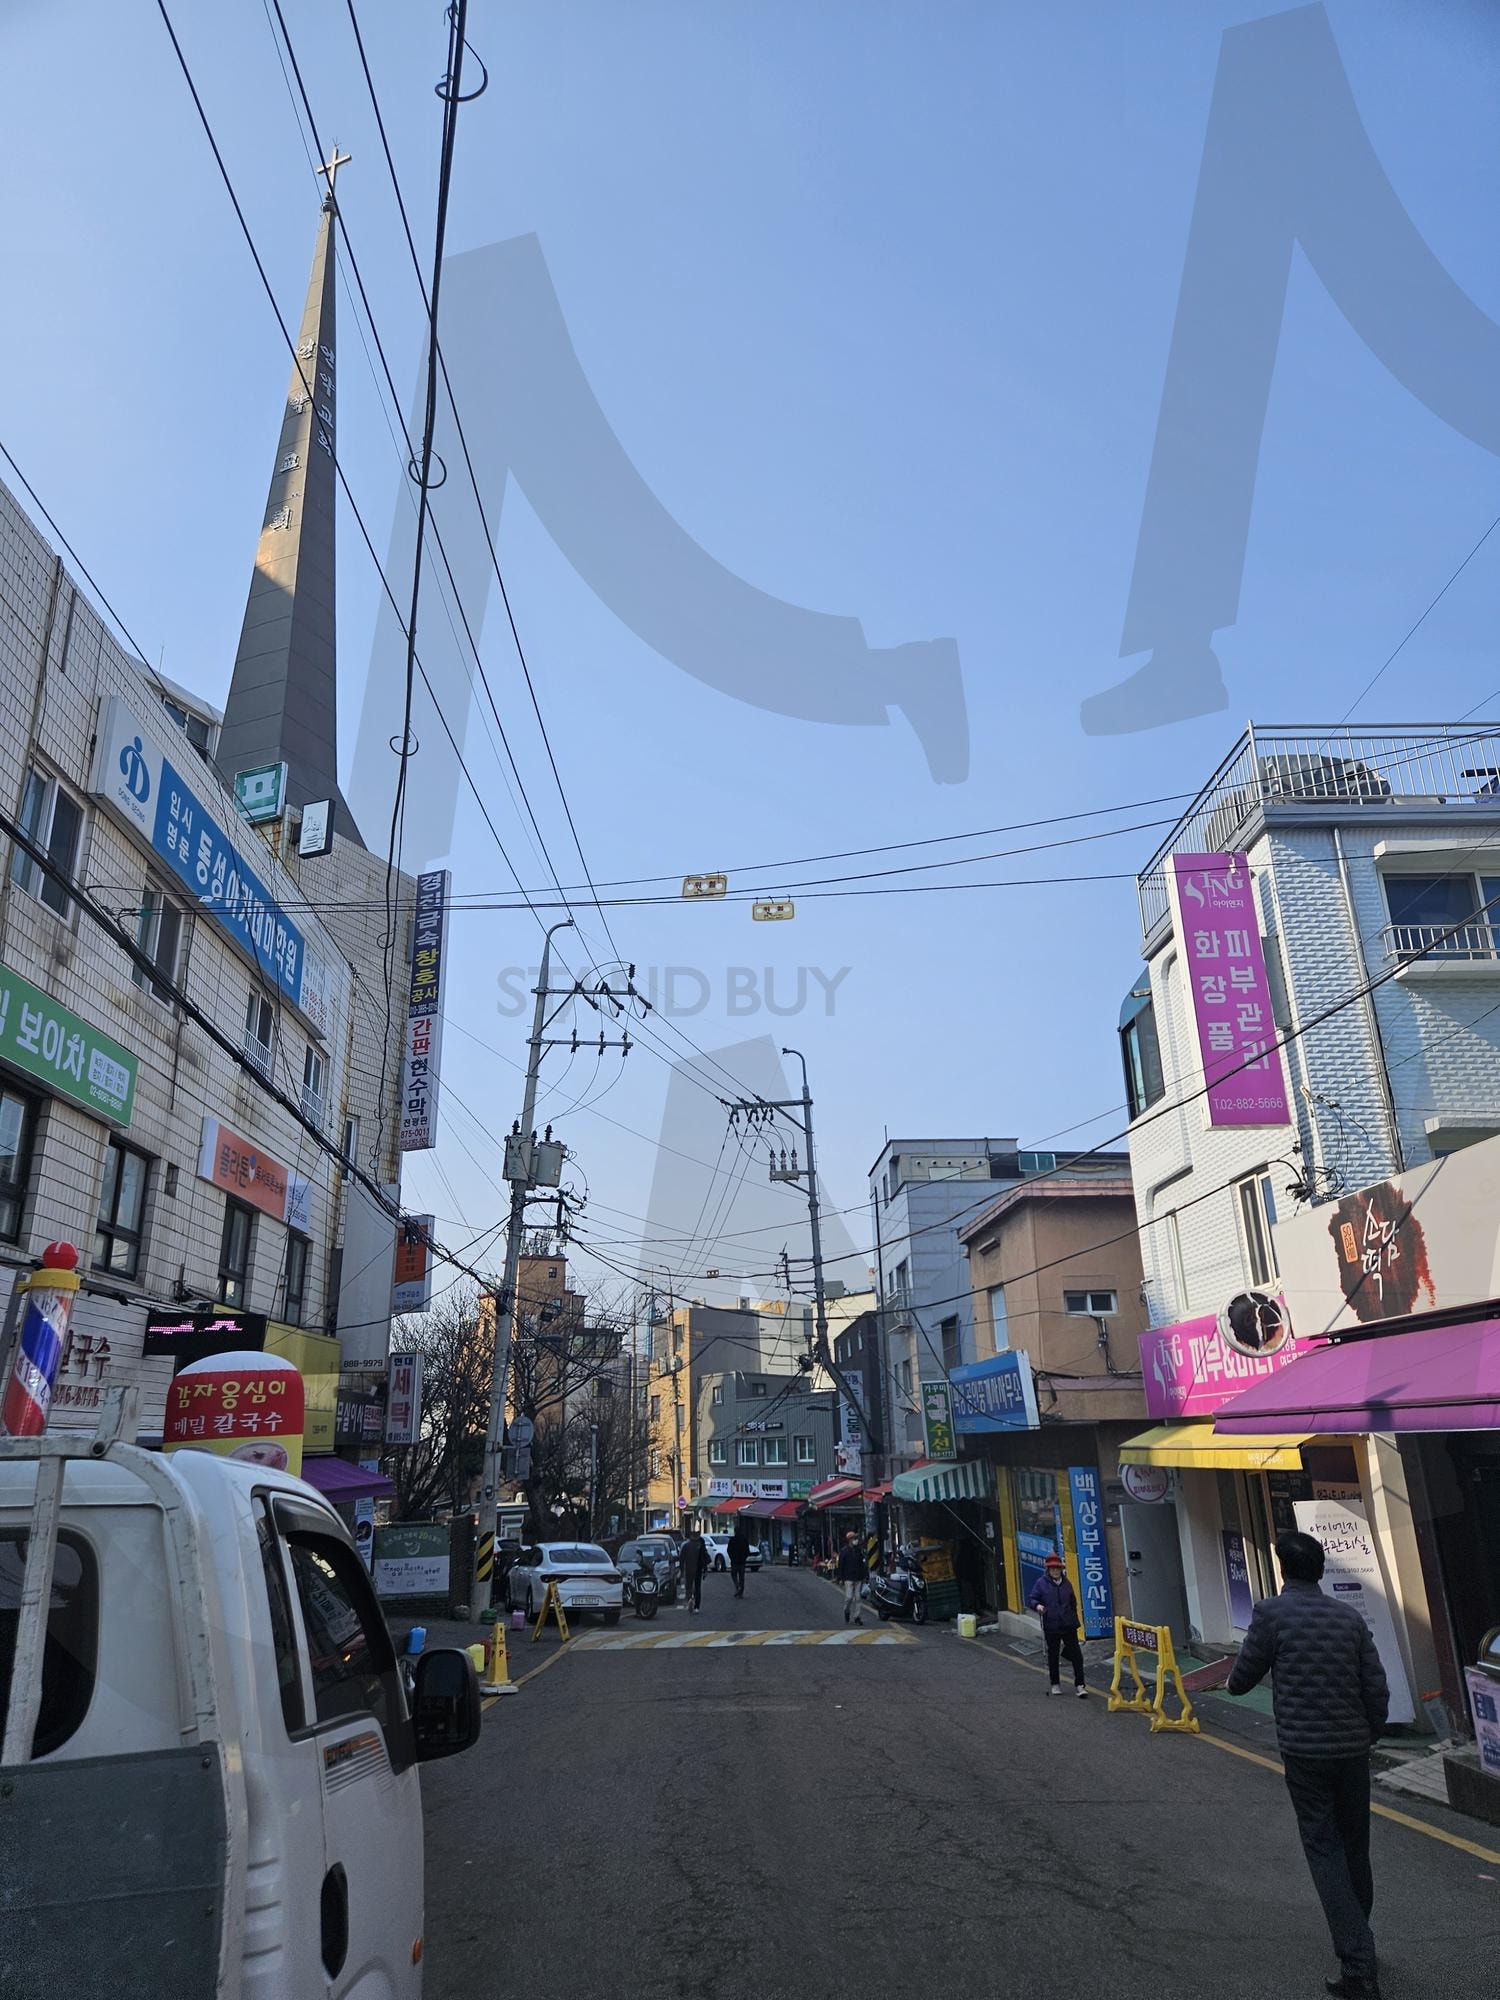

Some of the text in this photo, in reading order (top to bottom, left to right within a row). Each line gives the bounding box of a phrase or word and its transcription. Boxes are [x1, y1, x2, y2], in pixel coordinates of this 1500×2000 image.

[170, 790, 193, 834] 입시
[166, 825, 191, 864] 명문
[411, 986, 438, 1003] 공사
[1193, 930, 1235, 1051] 화장품
[1224, 930, 1270, 1070] 피부관리
[16, 1002, 86, 1082] 보이차
[411, 1018, 433, 1057] 간판
[408, 1058, 428, 1116] 현수막
[391, 1368, 411, 1429] 세탁
[174, 1411, 284, 1435] 메밀 칼국수
[929, 1423, 950, 1451] 수선
[1074, 1473, 1108, 1611] 백상부동산
[1320, 1535, 1371, 1555] 부관리실
